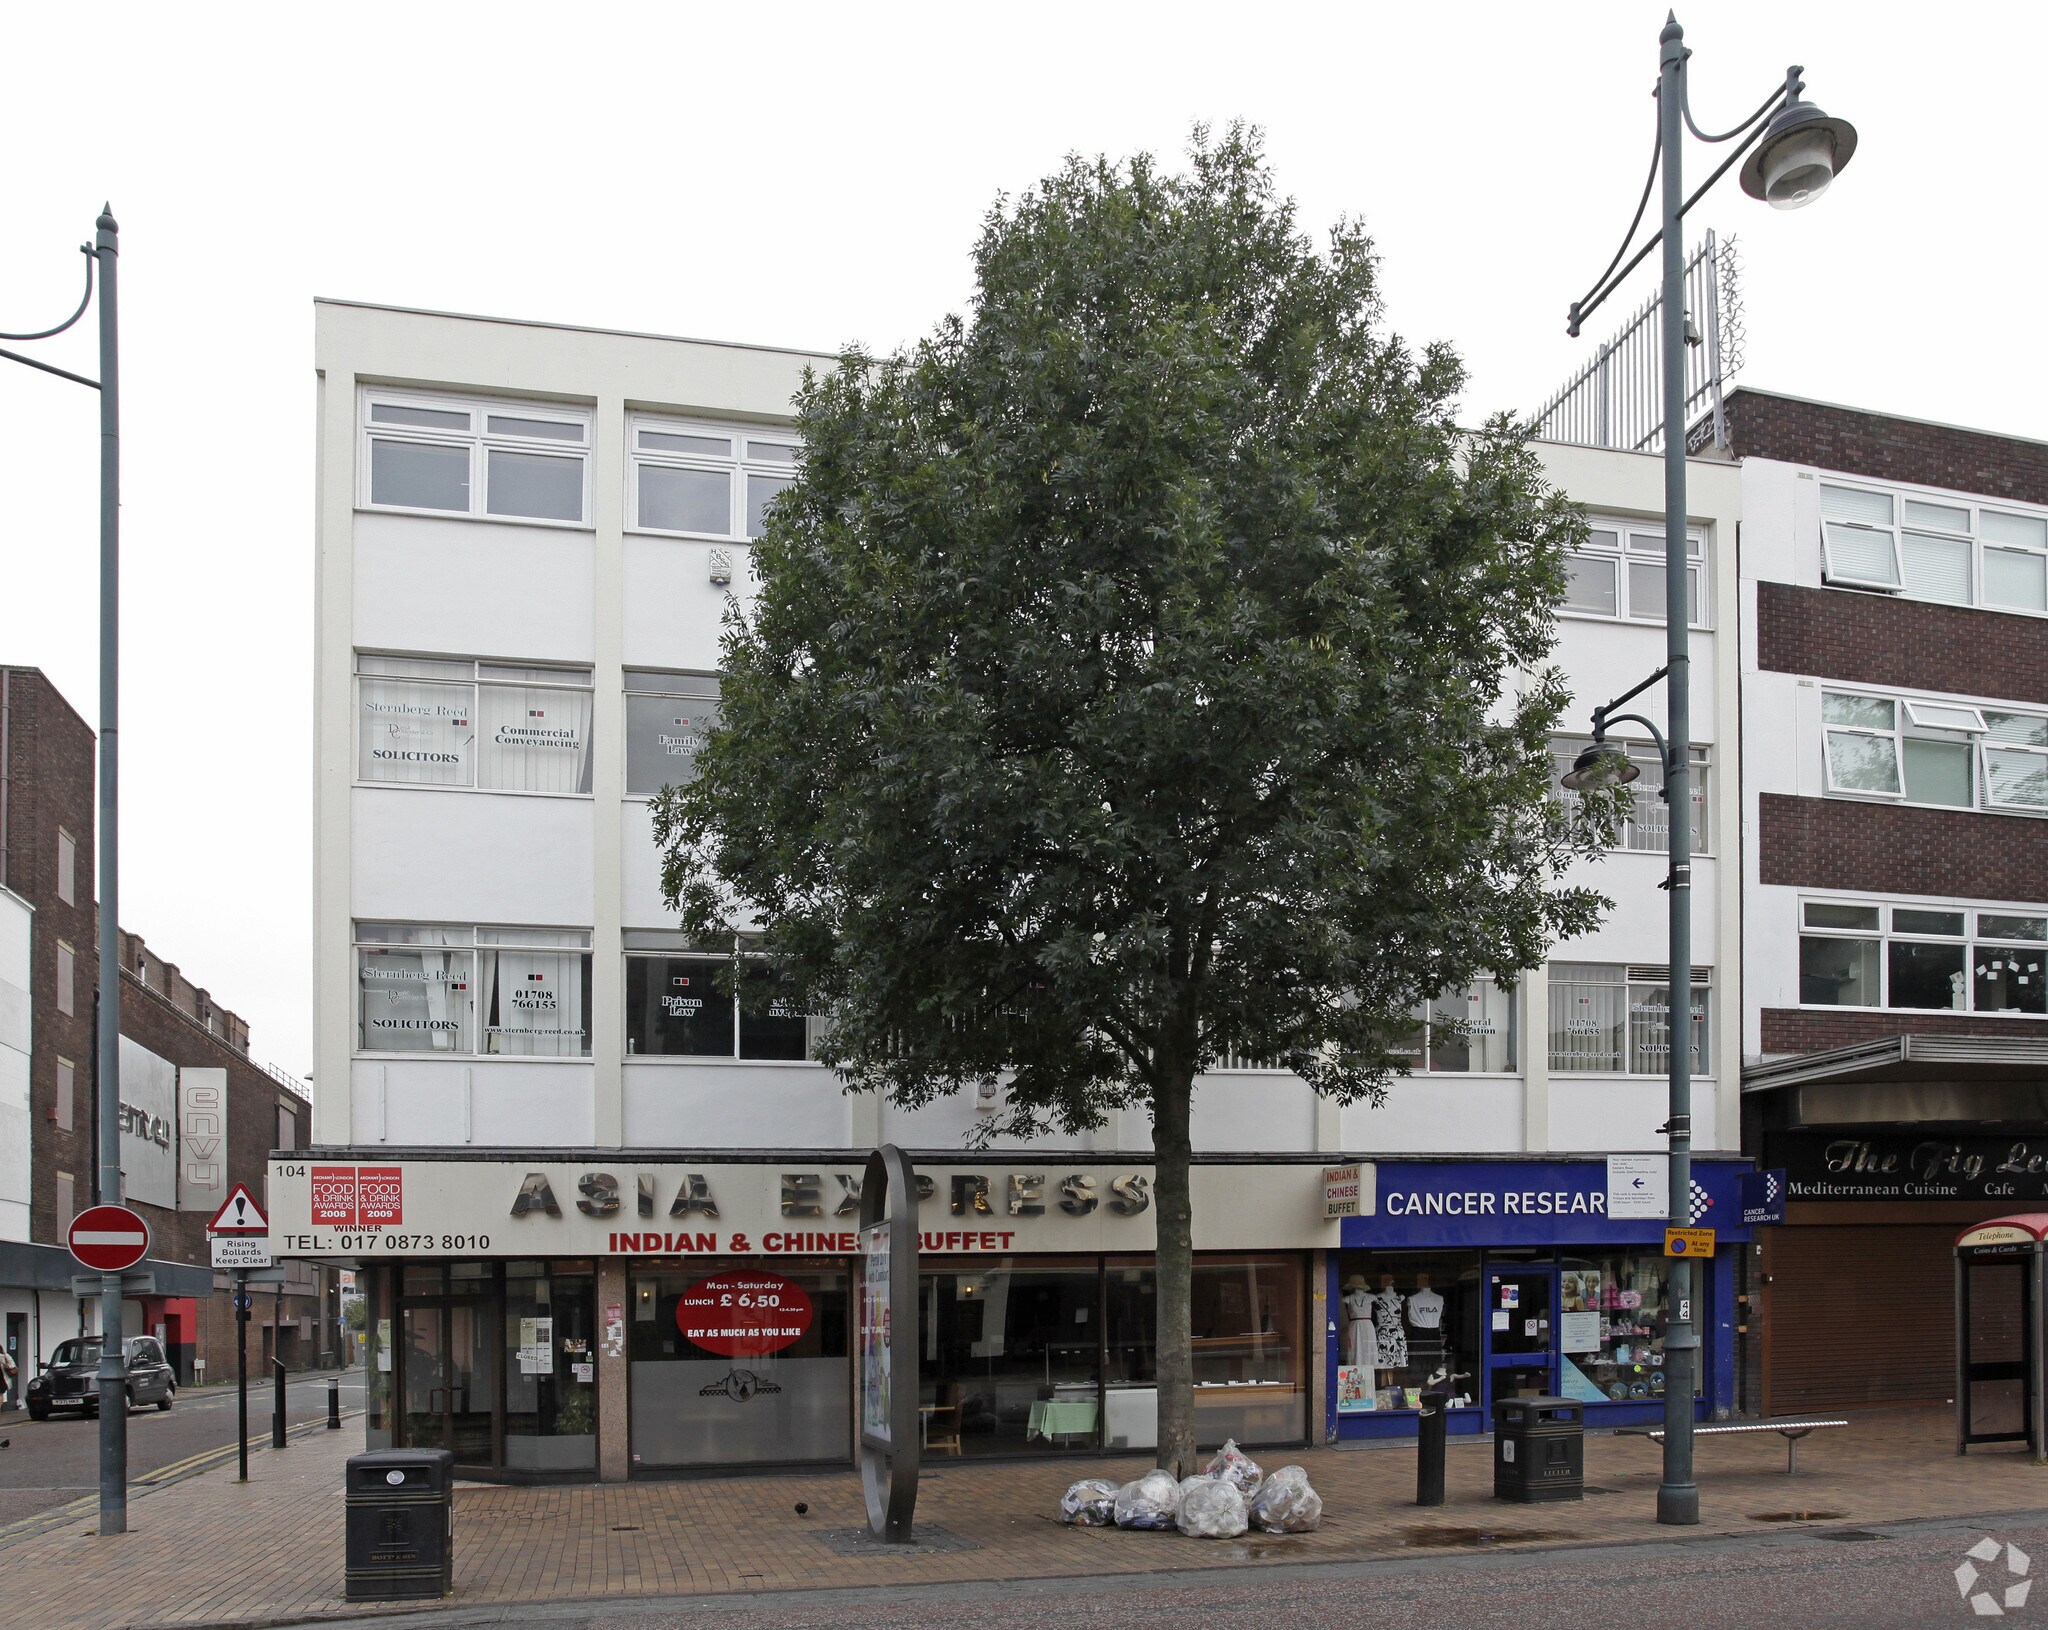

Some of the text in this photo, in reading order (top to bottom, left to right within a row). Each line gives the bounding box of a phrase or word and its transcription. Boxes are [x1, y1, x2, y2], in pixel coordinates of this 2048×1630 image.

[364, 702, 468, 718] Sternberg Reed
[500, 725, 575, 738] Commercial
[494, 734, 580, 750] Conveyancing
[658, 734, 700, 748] Family
[372, 749, 460, 763] SOLICITORS
[666, 746, 692, 755] Law
[362, 967, 466, 982] Sternberg Reed
[515, 990, 553, 1000] 01708
[512, 999, 556, 1010] 766155
[662, 996, 702, 1008] Prison
[1631, 1002, 1670, 1013] Sternbe
[670, 1006, 696, 1016] Law
[372, 1018, 459, 1030] SOLICITORS
[1569, 1020, 1597, 1028] 01708
[484, 1026, 586, 1036] www.sternberg-reed.co.uk
[1566, 1028, 1600, 1036] 766155
[1825, 1140, 2048, 1181] The Fig Le
[276, 1166, 306, 1177] 104
[1326, 1169, 1359, 1182] INDIAN &
[313, 1184, 354, 1194] FOOD
[360, 1184, 400, 1194] FOOD
[509, 1172, 720, 1217] ASIA
[1326, 1186, 1358, 1199] CHINESE
[1788, 1182, 2015, 1196] Mediterranean Cuisine Cafe
[1328, 1202, 1356, 1214] BUFFET
[1387, 1192, 1606, 1216] CANCER RESEAR
[1744, 1214, 1771, 1223] RESEARCH
[284, 1235, 490, 1250] TEL: 017 0873 8010
[609, 1233, 717, 1252] INDIAN
[730, 1233, 752, 1252] &
[762, 1232, 862, 1252] CHINE
[1978, 1232, 2014, 1241] Telephone
[227, 1240, 256, 1248] Rising
[215, 1257, 239, 1265] Keep
[737, 1281, 784, 1291] Saturday
[720, 1294, 732, 1306] £
[688, 1329, 704, 1337] EAT
[706, 1329, 719, 1337] AS
[720, 1328, 745, 1337] MUCH
[761, 1328, 779, 1336] YOU
